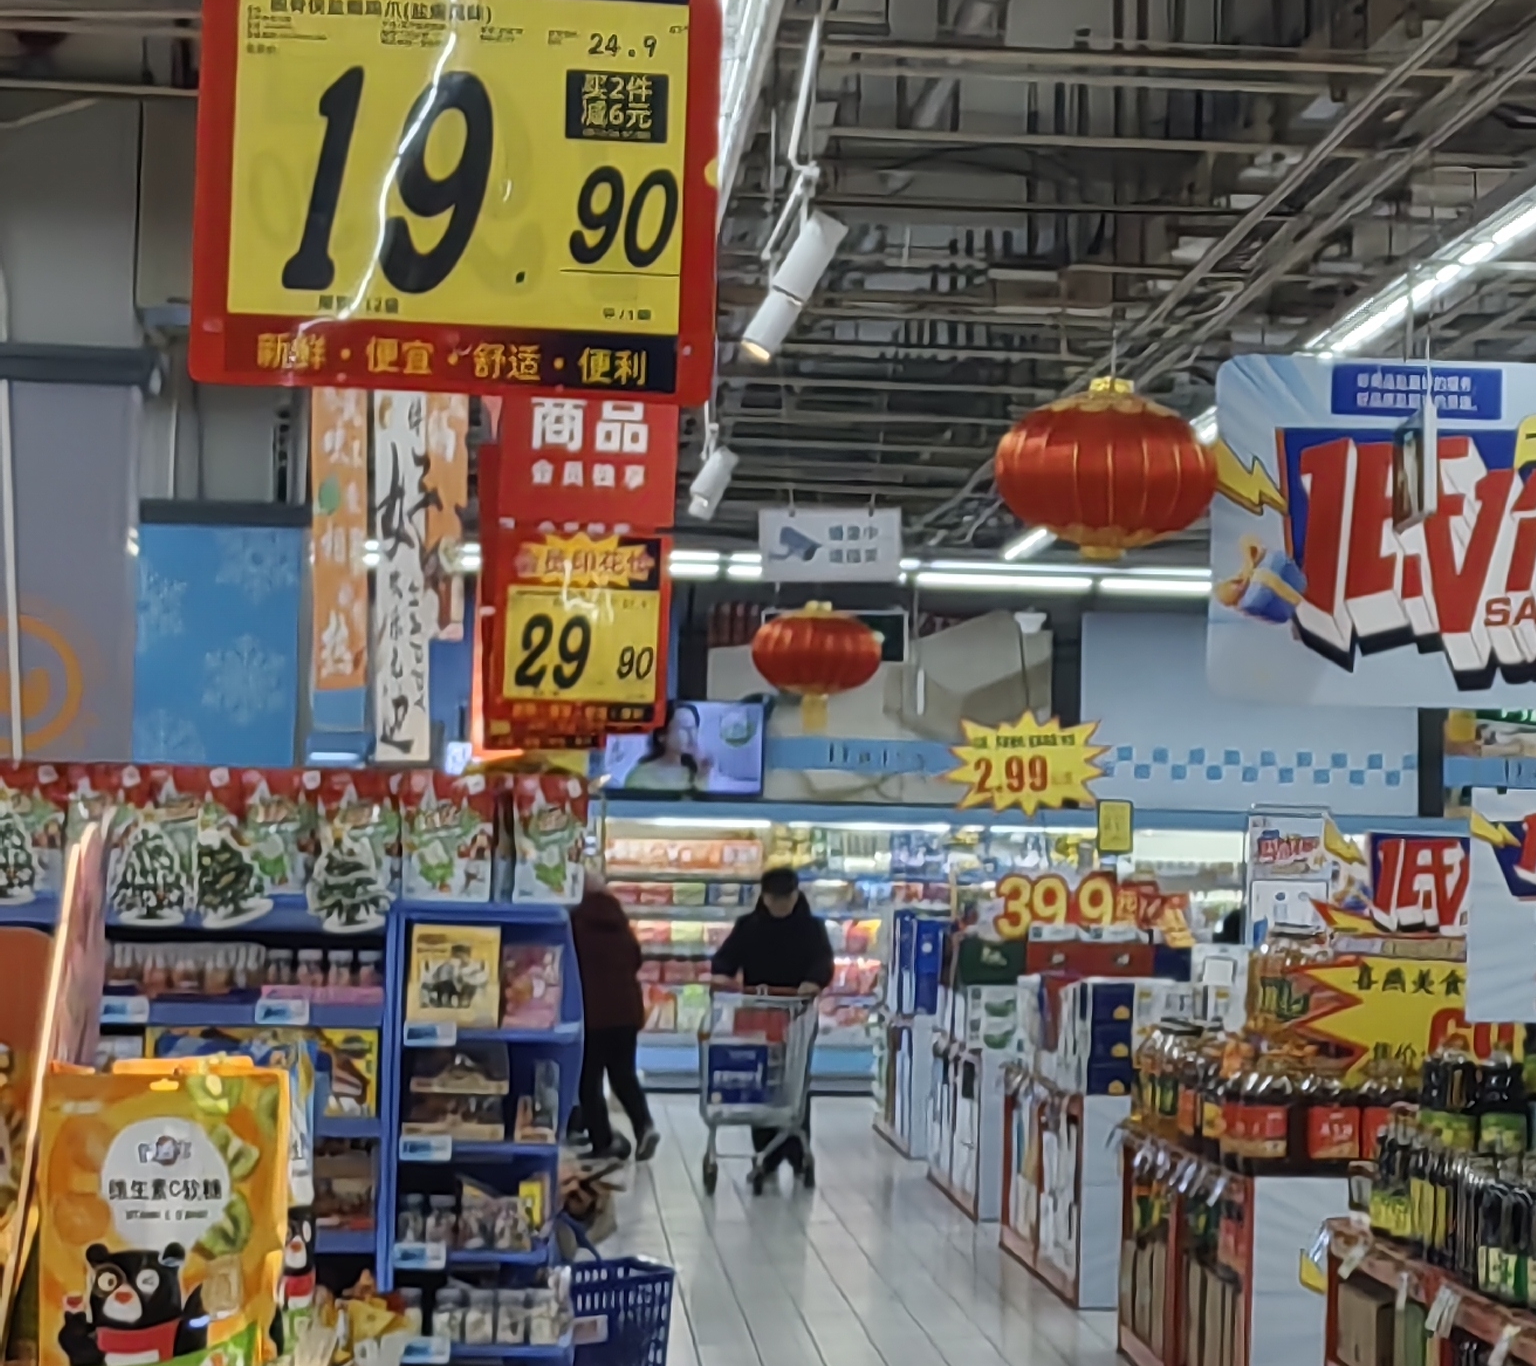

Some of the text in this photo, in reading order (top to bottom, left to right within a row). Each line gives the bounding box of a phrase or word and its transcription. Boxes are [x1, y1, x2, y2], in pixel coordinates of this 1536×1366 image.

[587, 32, 658, 58] 24.9
[581, 73, 653, 103] 买2件
[581, 99, 653, 130] 减6元
[569, 164, 679, 269] 90
[530, 397, 649, 454] 商品
[514, 613, 654, 691] 29 90
[973, 754, 1048, 793] 2.99
